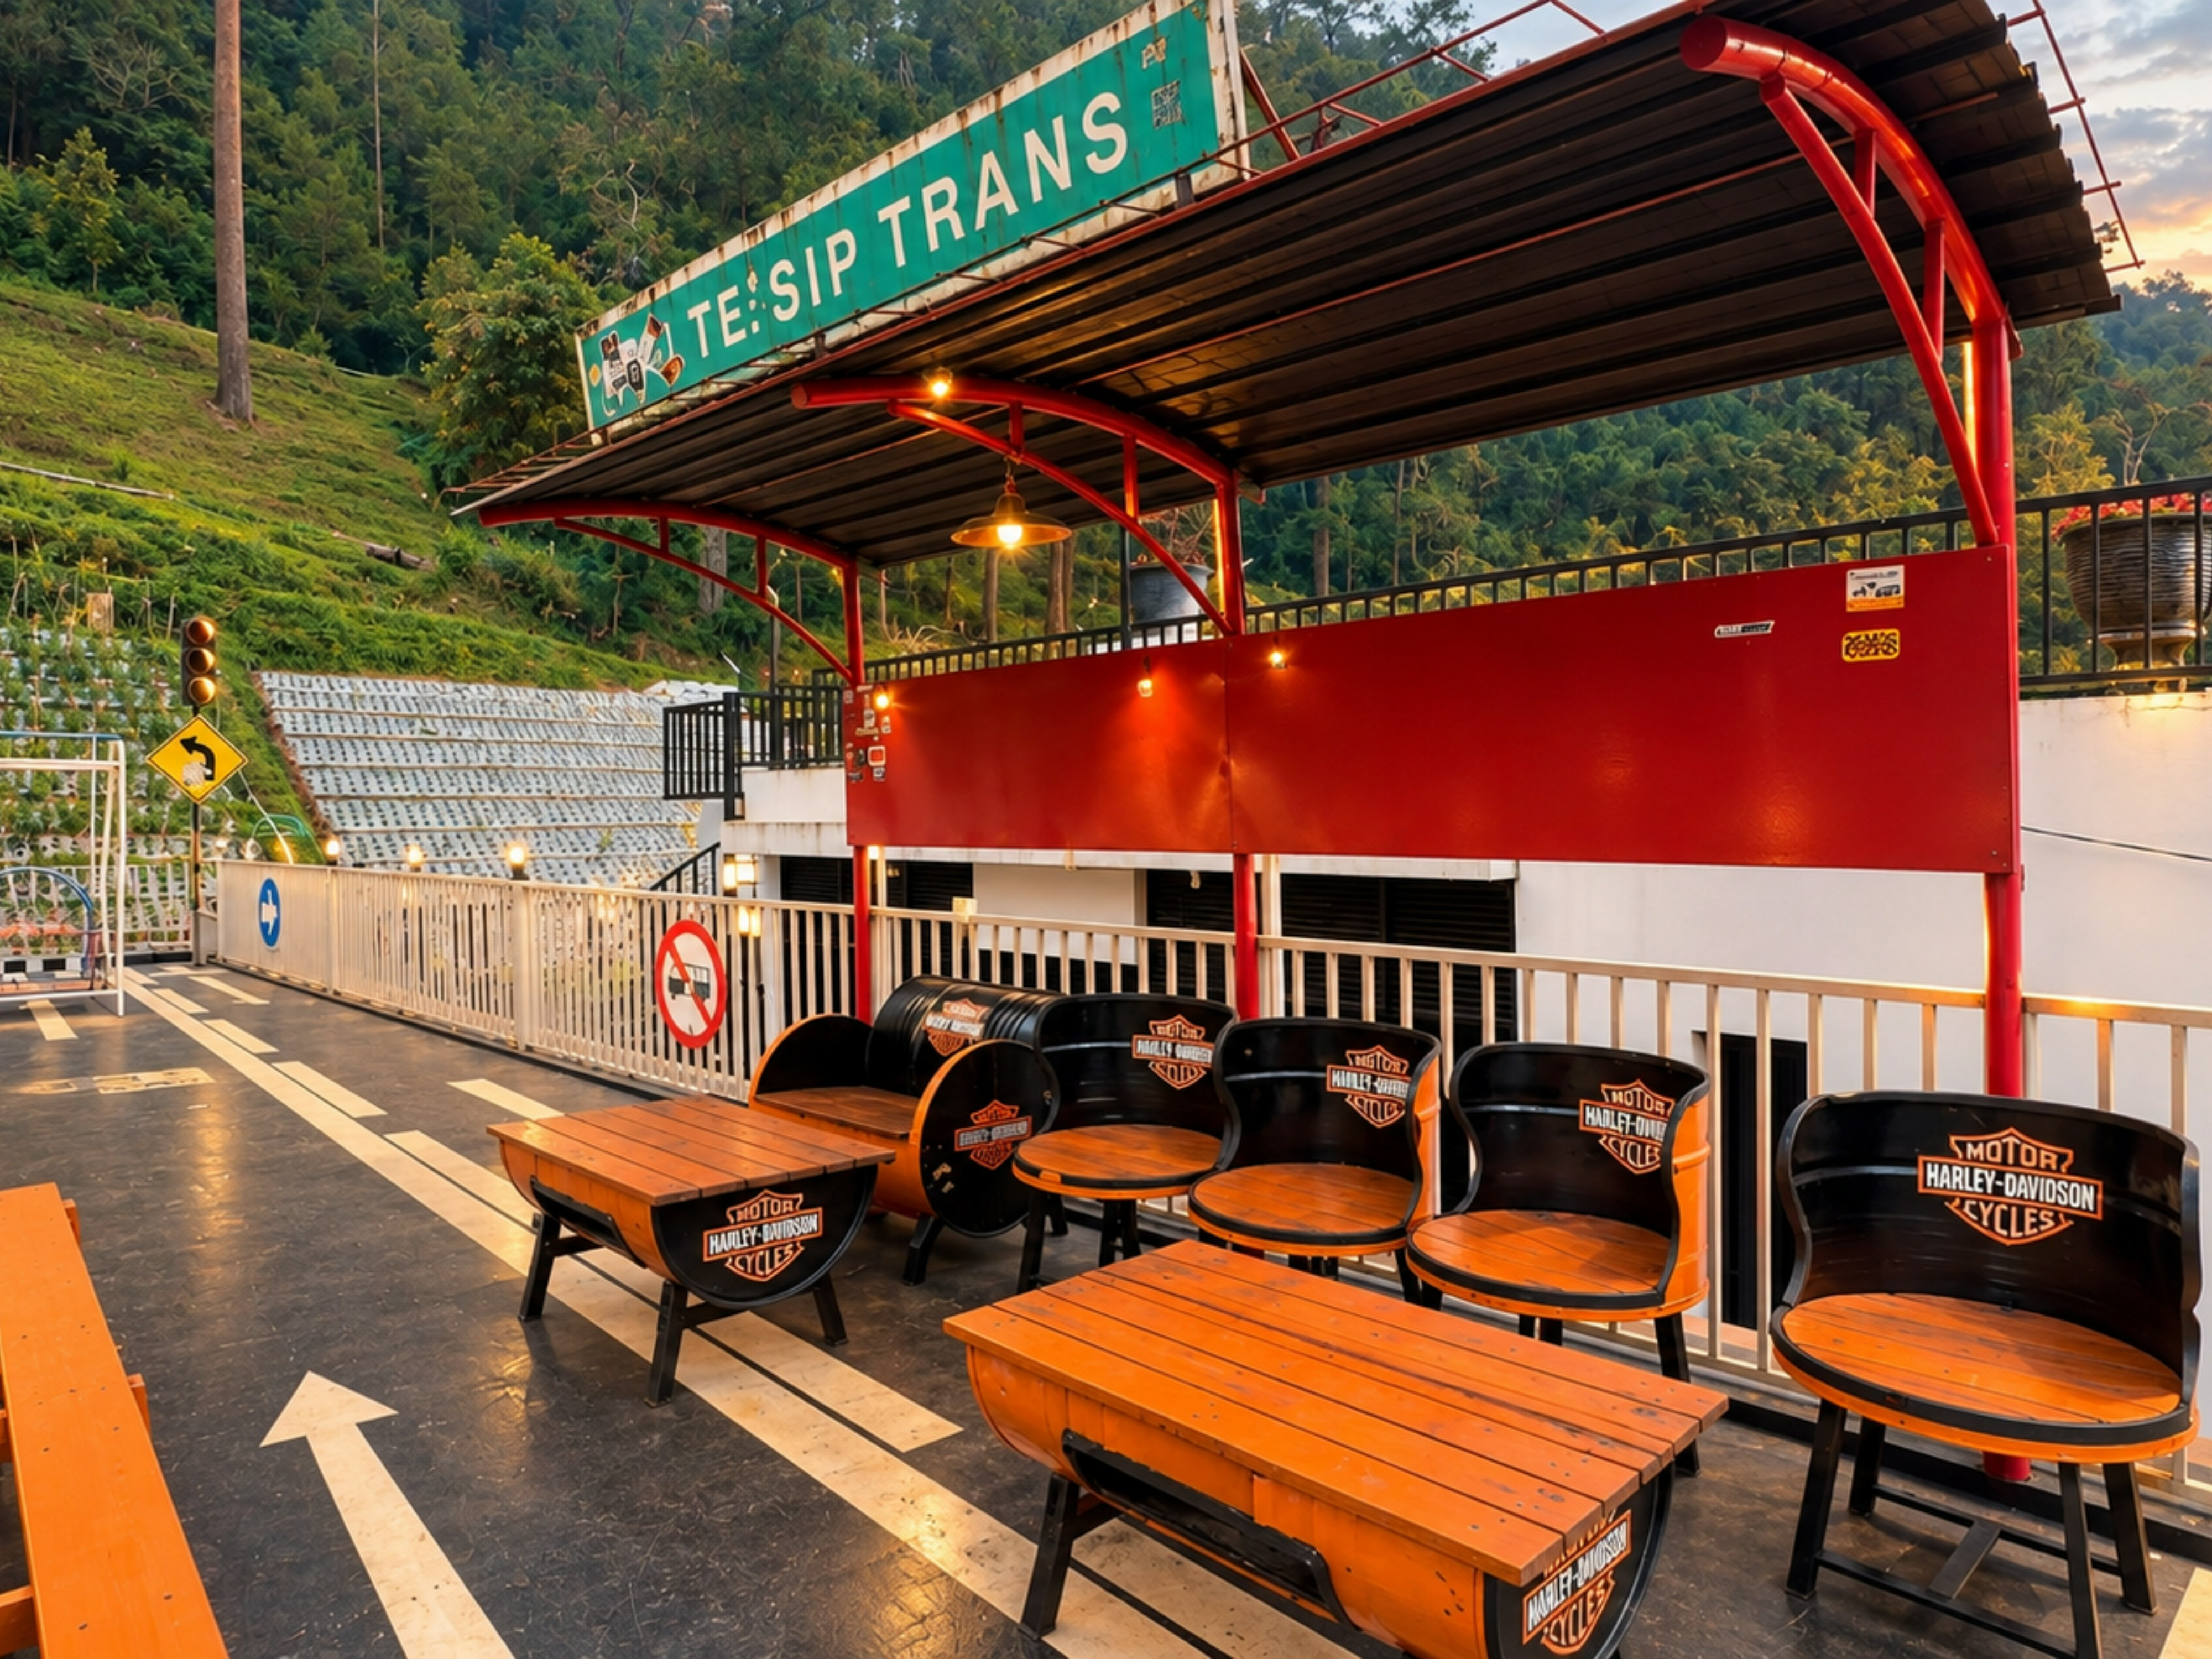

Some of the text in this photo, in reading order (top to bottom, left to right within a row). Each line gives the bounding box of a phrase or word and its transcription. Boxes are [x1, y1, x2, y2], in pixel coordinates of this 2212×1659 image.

[877, 92, 1128, 268] TRANS
[1611, 1087, 1665, 1115] MOTOR
[1966, 1135, 2058, 1171] MOTOR
[1926, 1162, 2095, 1212] HARLEY-DAVIDSON
[736, 1197, 794, 1223] MOTOR
[1963, 1200, 2056, 1238] CYCLES
[734, 1244, 794, 1276] CYCLES
